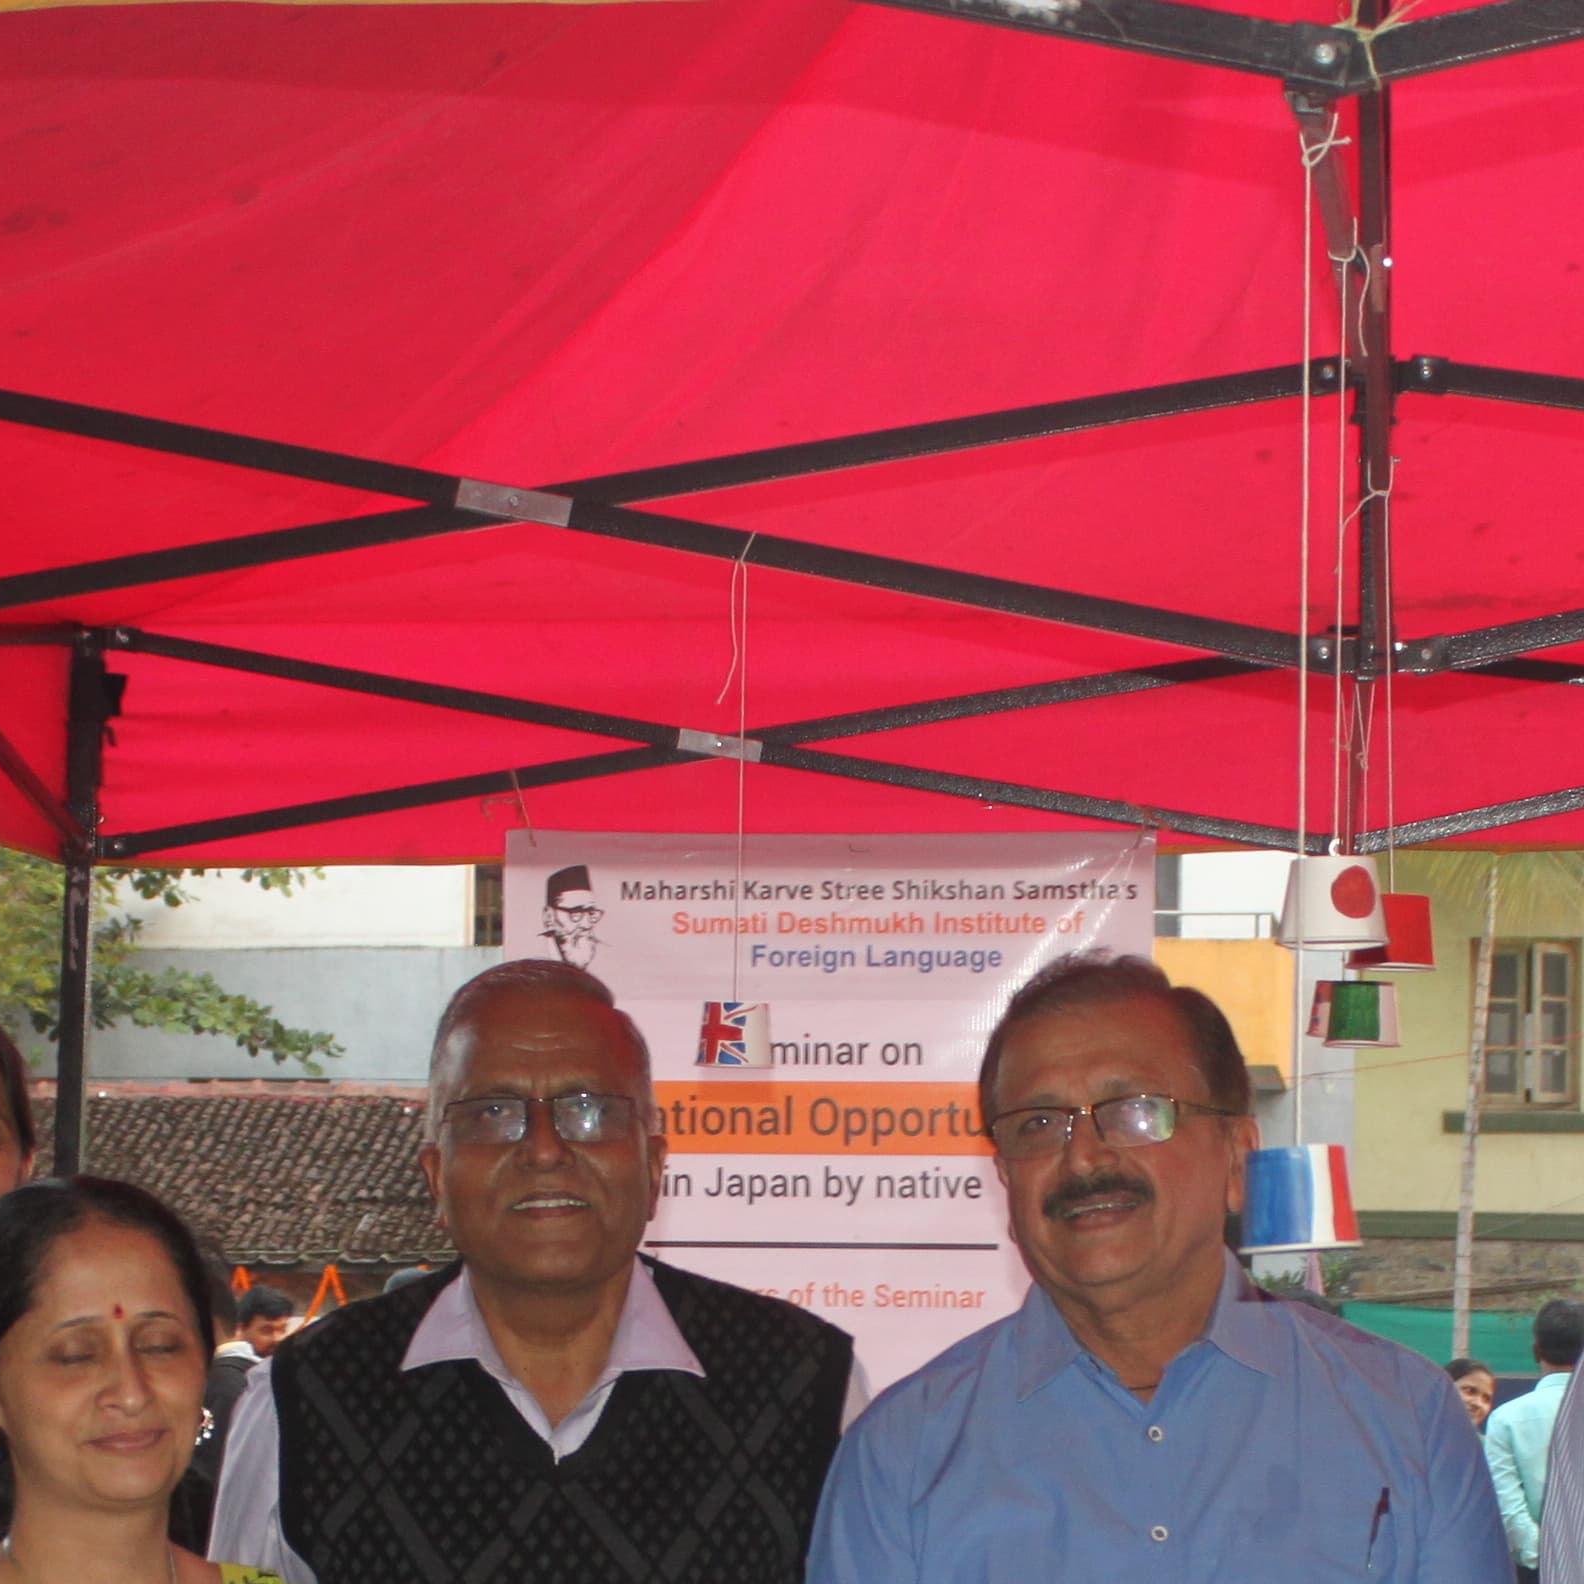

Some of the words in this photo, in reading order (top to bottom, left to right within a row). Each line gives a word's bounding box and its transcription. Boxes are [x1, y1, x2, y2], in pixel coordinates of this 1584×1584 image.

[621, 880, 735, 900] Maharshi
[743, 881, 813, 900] Karve
[821, 881, 884, 900] Stree
[892, 880, 1005, 900] Shikshan
[672, 911, 768, 935] Sumati
[777, 911, 924, 935] Deshmukh
[934, 911, 1047, 935] Institute
[1056, 911, 1085, 935] of
[751, 945, 856, 973] Foreign
[866, 945, 1002, 973] Language
[771, 1033, 869, 1066] minar
[881, 1041, 922, 1066] on
[657, 1095, 793, 1136] ational
[809, 1096, 985, 1147] Opportu
[704, 1166, 810, 1205] Japan
[824, 1165, 864, 1206] by
[875, 1166, 982, 1199] native
[822, 1283, 865, 1307] the
[874, 1283, 986, 1308] Seminar
